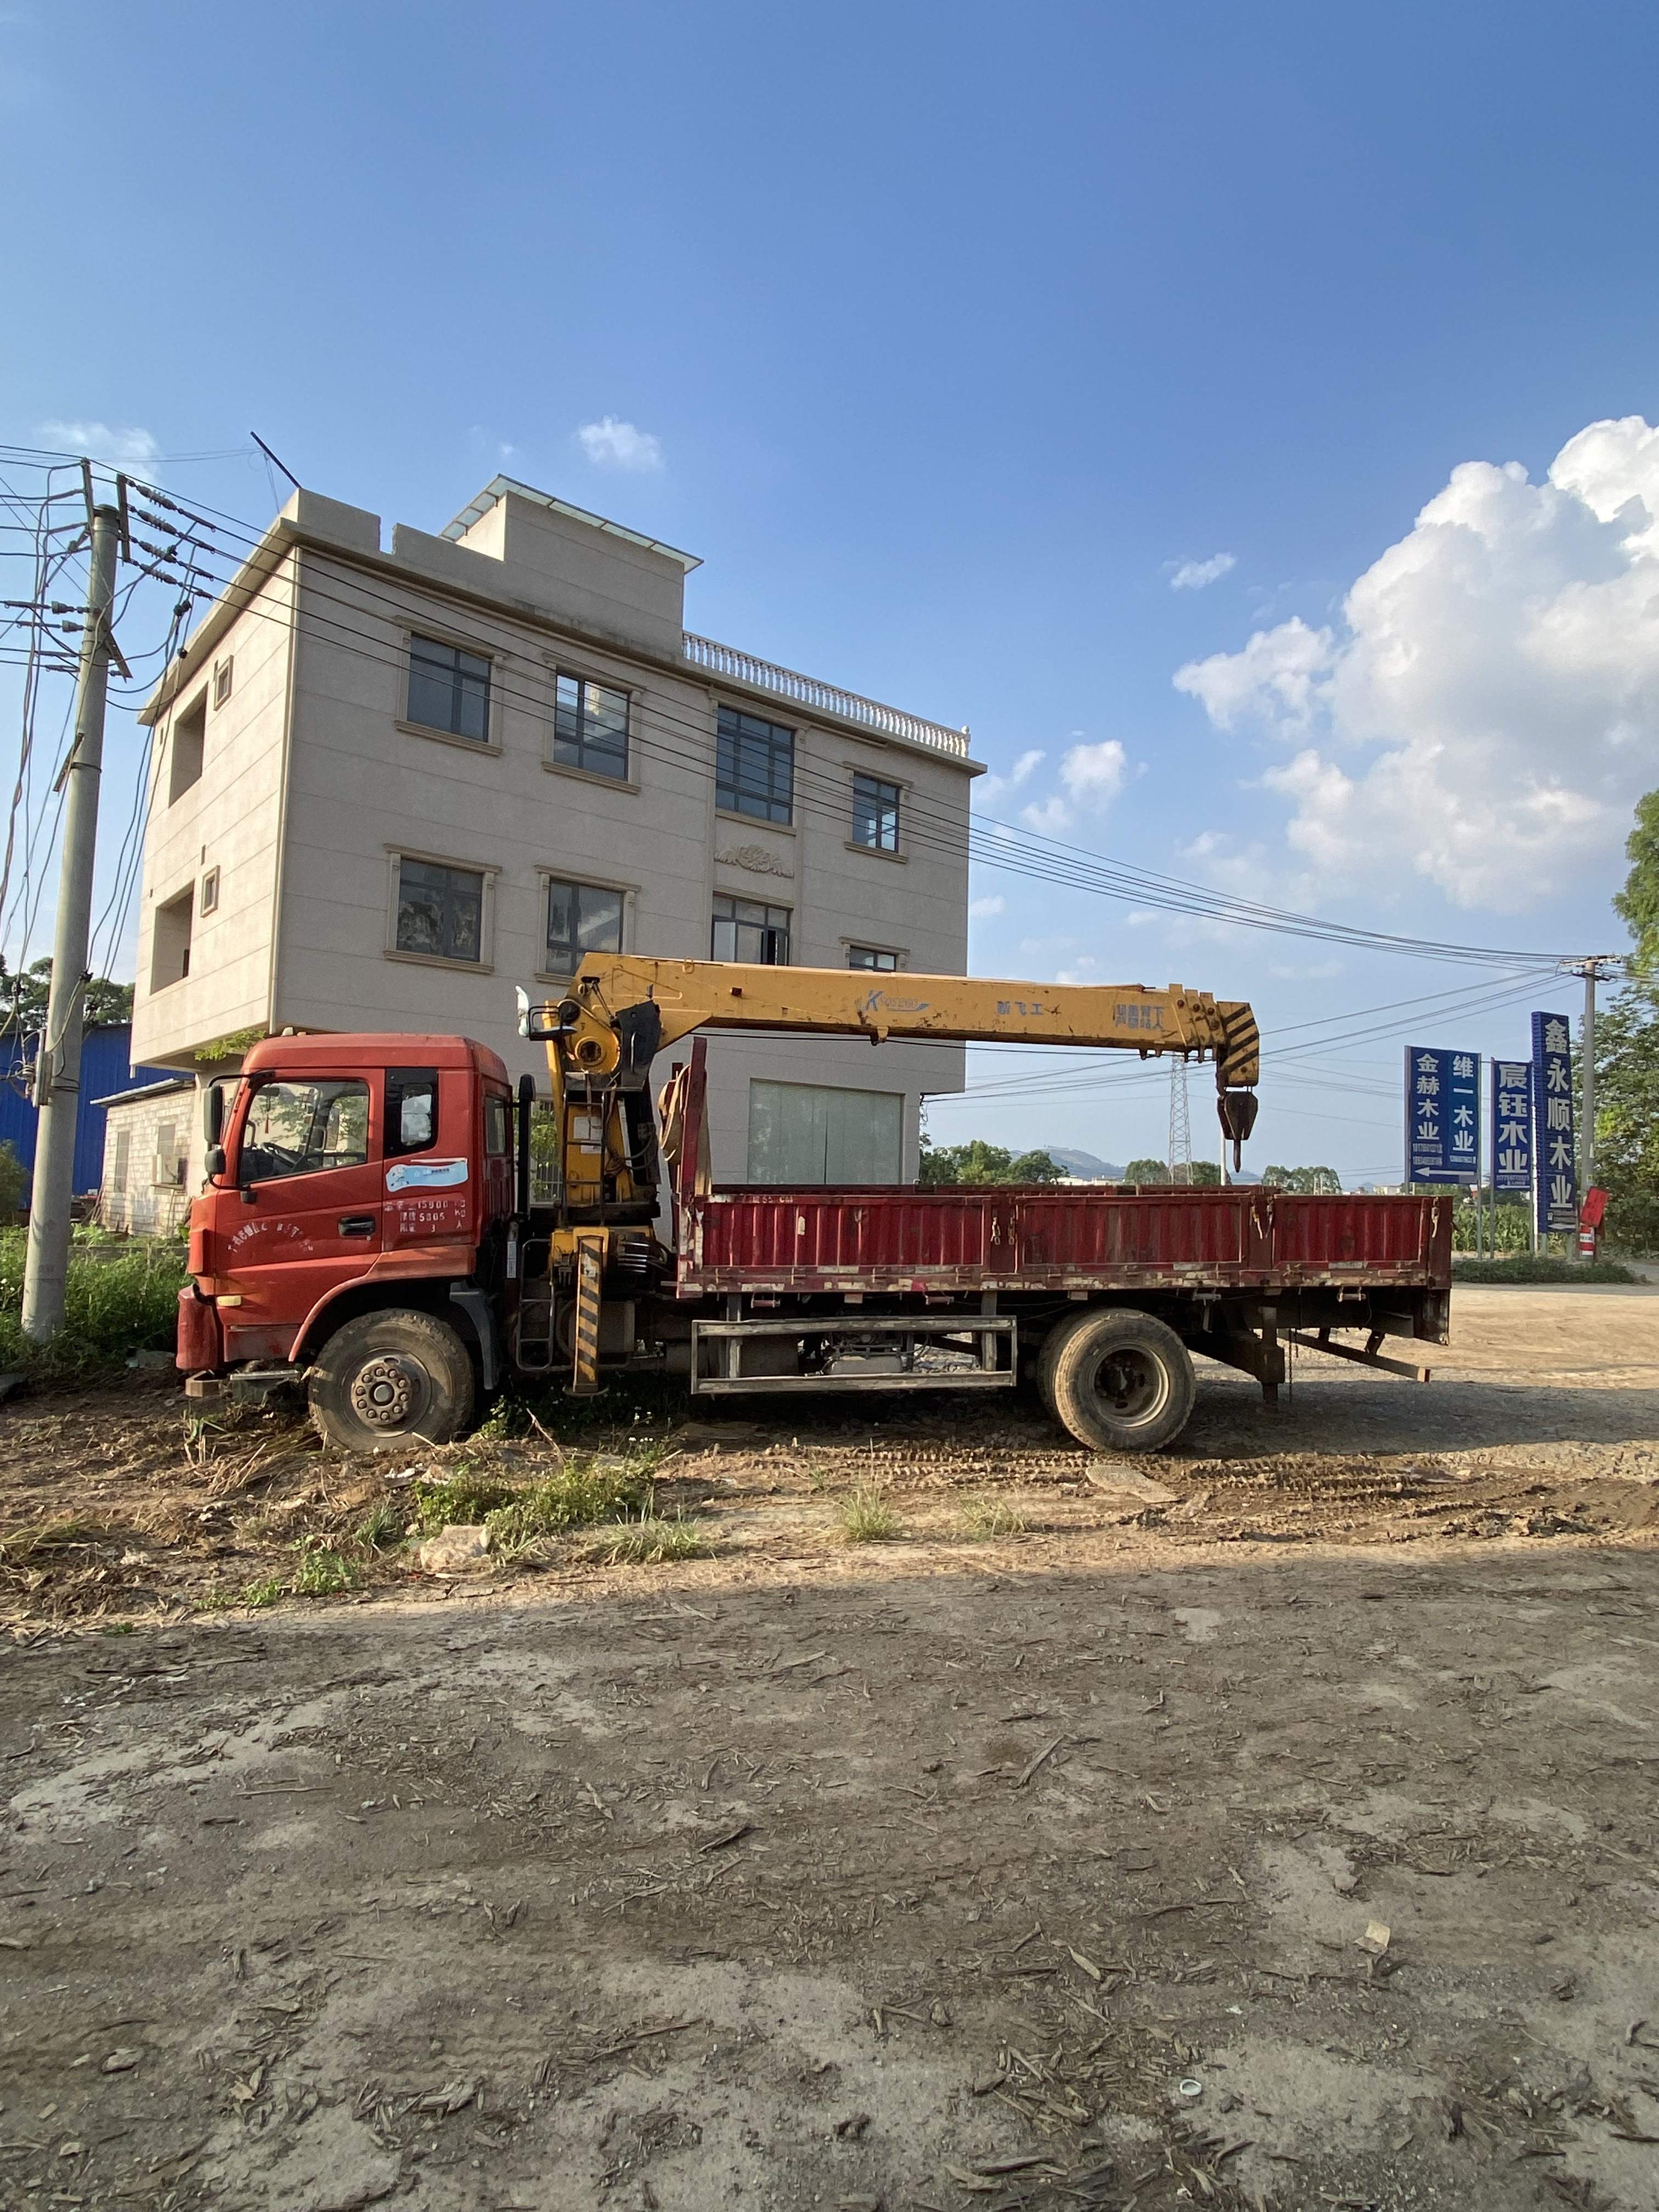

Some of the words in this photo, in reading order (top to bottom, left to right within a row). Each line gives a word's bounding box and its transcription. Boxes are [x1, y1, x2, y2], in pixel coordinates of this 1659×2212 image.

[1416, 1053, 1440, 1140] 金赫木业
[1453, 1055, 1474, 1152] 维一木业
[1498, 1064, 1528, 1174] 宸钰木业
[1544, 1019, 1573, 1208] 鑫永顺木业
